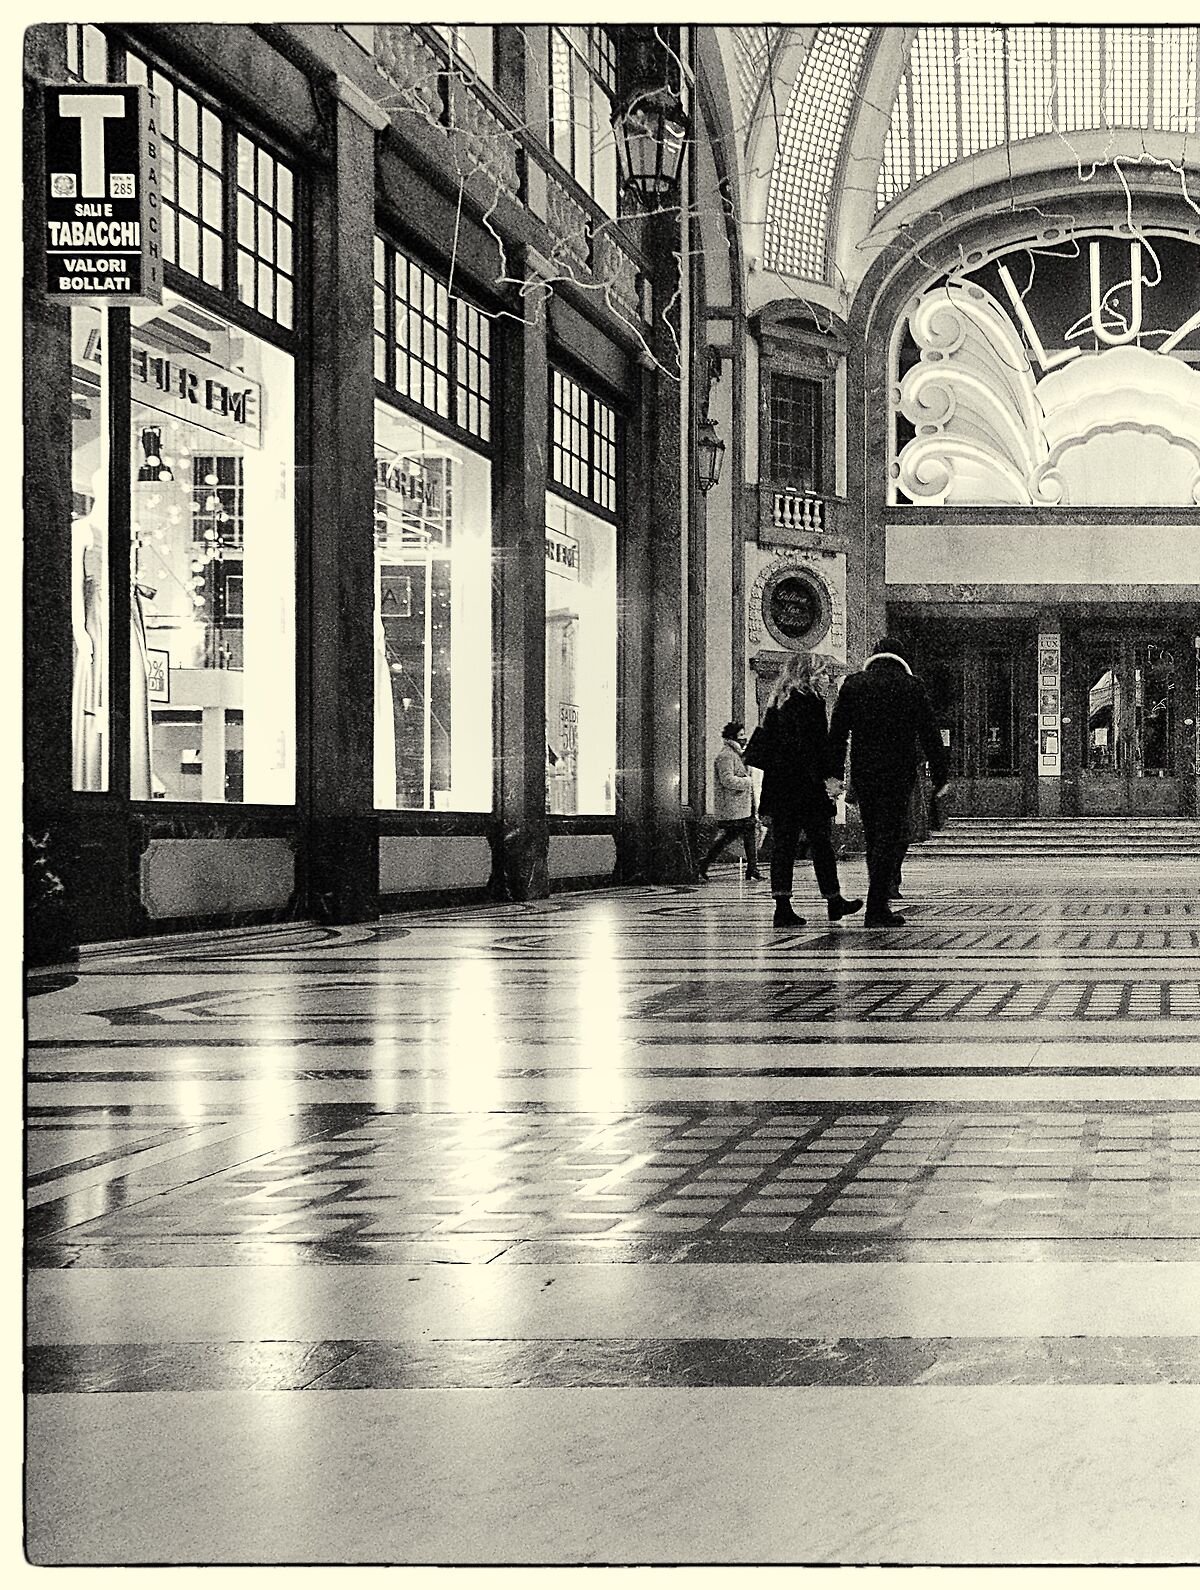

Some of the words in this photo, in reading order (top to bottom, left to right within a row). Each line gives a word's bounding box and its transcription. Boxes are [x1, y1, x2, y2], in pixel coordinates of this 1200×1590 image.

[58, 94, 126, 198] T
[113, 183, 133, 195] 285
[148, 91, 159, 282] TABACCHI
[75, 203, 102, 217] SALI
[104, 203, 113, 217] E
[47, 221, 141, 247] TABACCHI
[63, 258, 127, 273] VALORI
[59, 277, 131, 291] BOLLATI
